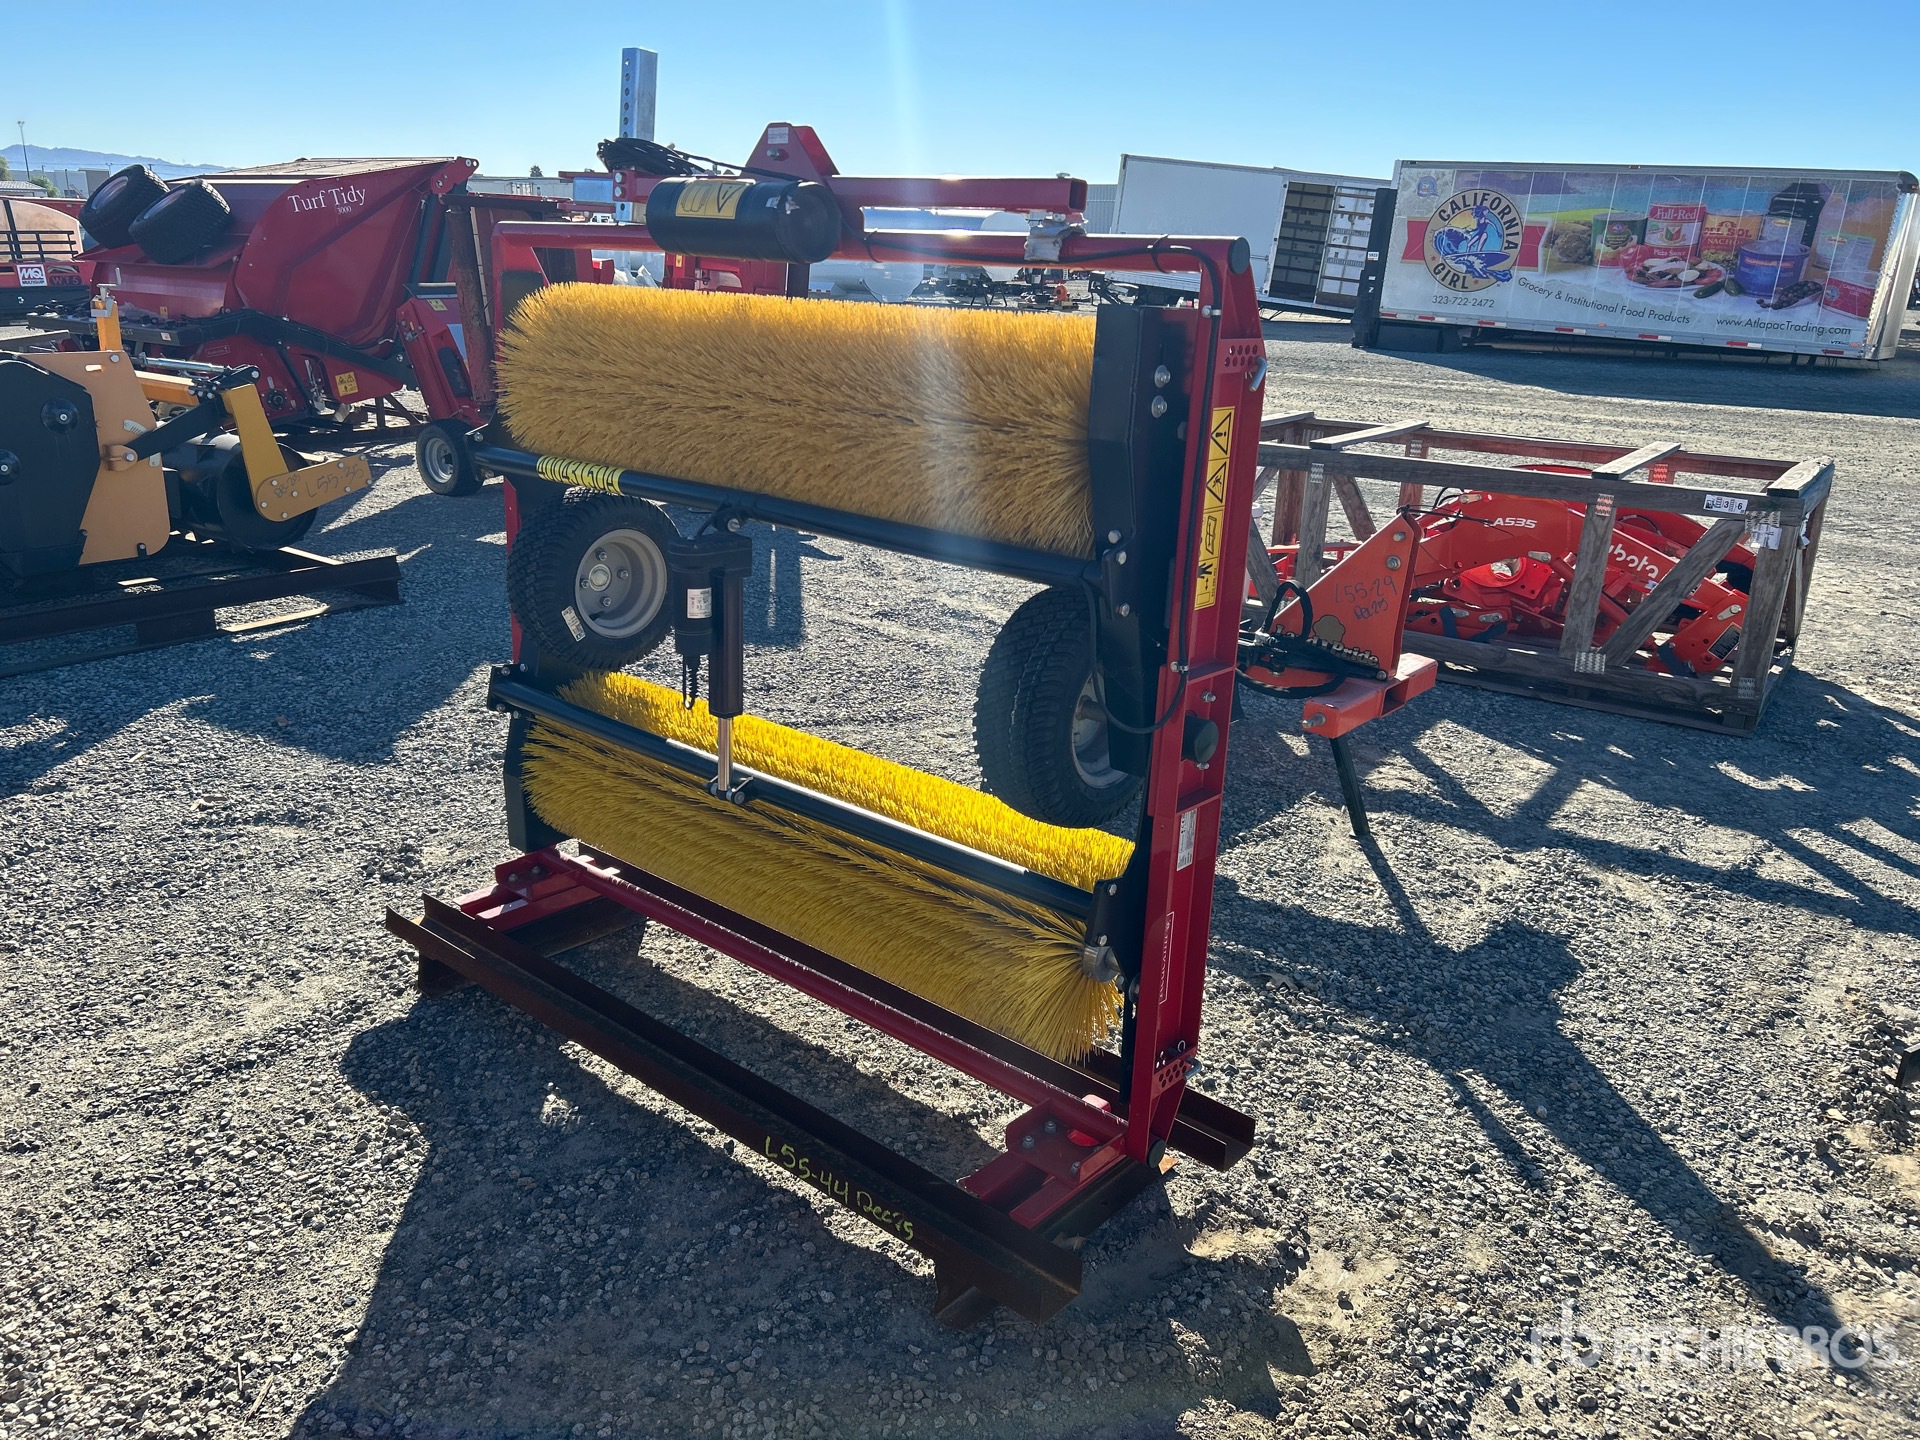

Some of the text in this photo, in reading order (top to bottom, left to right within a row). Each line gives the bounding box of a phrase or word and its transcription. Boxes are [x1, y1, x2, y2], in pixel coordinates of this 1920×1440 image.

[287, 185, 366, 213] Turf Tidy
[337, 205, 352, 215] 3000
[1656, 207, 1697, 220] Full-Red
[1438, 192, 1520, 251] CALIFORNIA
[20, 267, 45, 279] MQ
[1432, 262, 1469, 290] GIRL
[1432, 295, 1495, 308] 323-722-2472
[1518, 277, 1691, 324] Grocery & Institutional Food Products
[1716, 317, 1851, 336] www.AtlapacTrading.com
